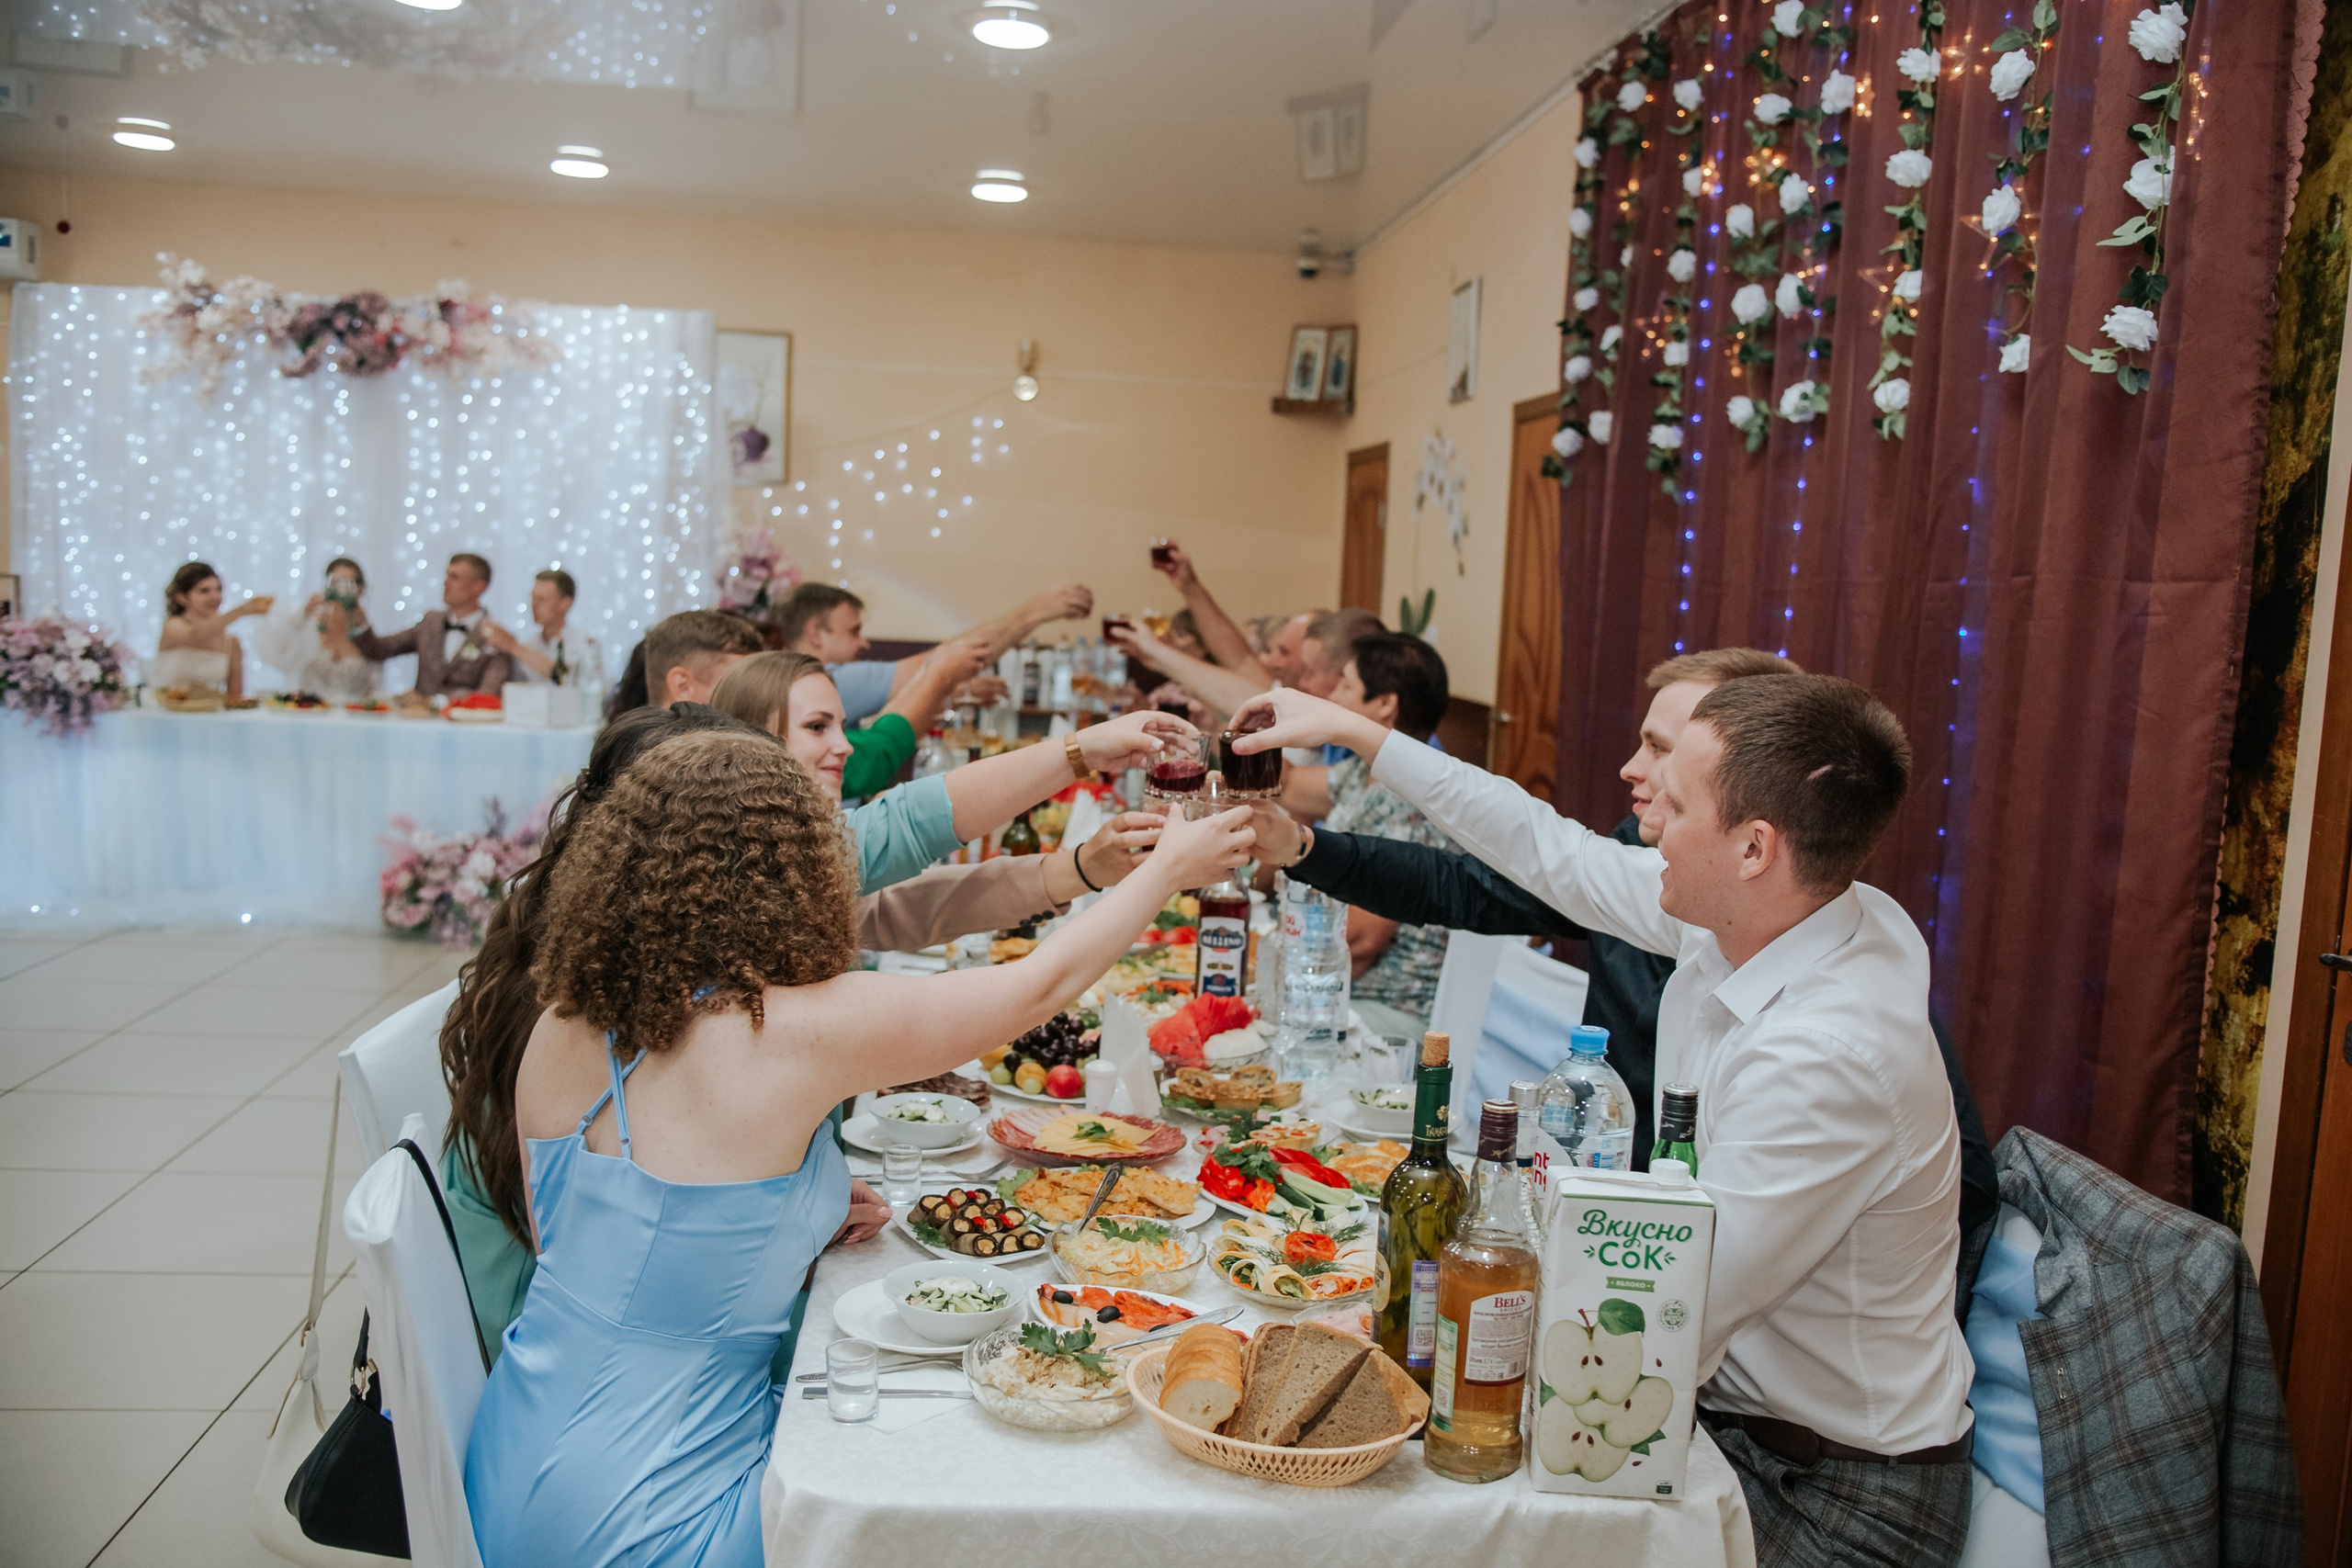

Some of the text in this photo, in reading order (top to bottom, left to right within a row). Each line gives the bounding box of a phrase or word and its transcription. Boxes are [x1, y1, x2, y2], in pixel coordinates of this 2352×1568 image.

[1577, 1209, 1693, 1248] Вкусно
[1615, 1280, 1646, 1289] ЯБЛОКО
[1494, 1294, 1526, 1309] BELL'S
